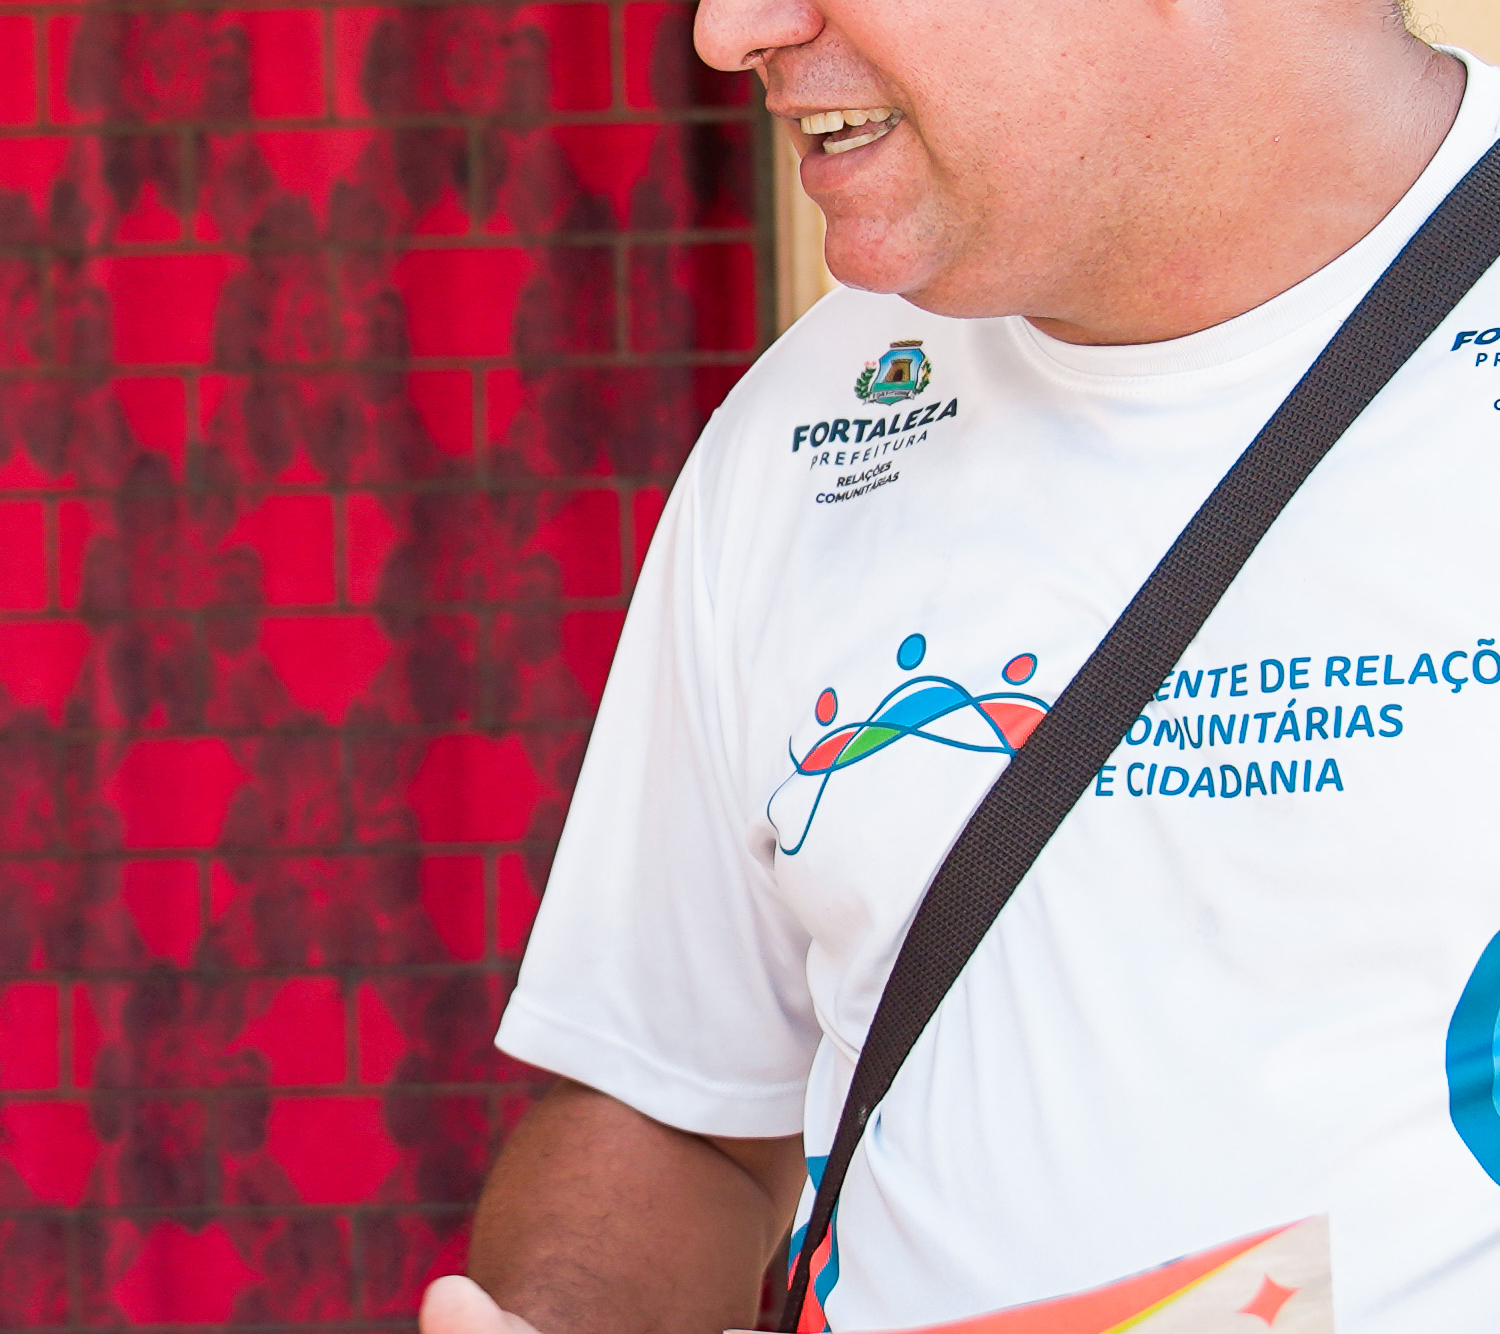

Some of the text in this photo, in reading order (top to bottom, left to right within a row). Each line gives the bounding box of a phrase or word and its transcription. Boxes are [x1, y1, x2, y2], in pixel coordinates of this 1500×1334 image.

[792, 398, 958, 453] FORTALEZA
[810, 430, 928, 470] PREFEITURA
[815, 471, 900, 504] COMUNITÁRIAS
[836, 461, 892, 488] RELAÇÕES
[1155, 663, 1249, 702] ENTE
[1260, 656, 1312, 693] DE
[1125, 698, 1404, 750] OMUNITÁRIAS
[1095, 758, 1344, 799] E CIDADANIA
